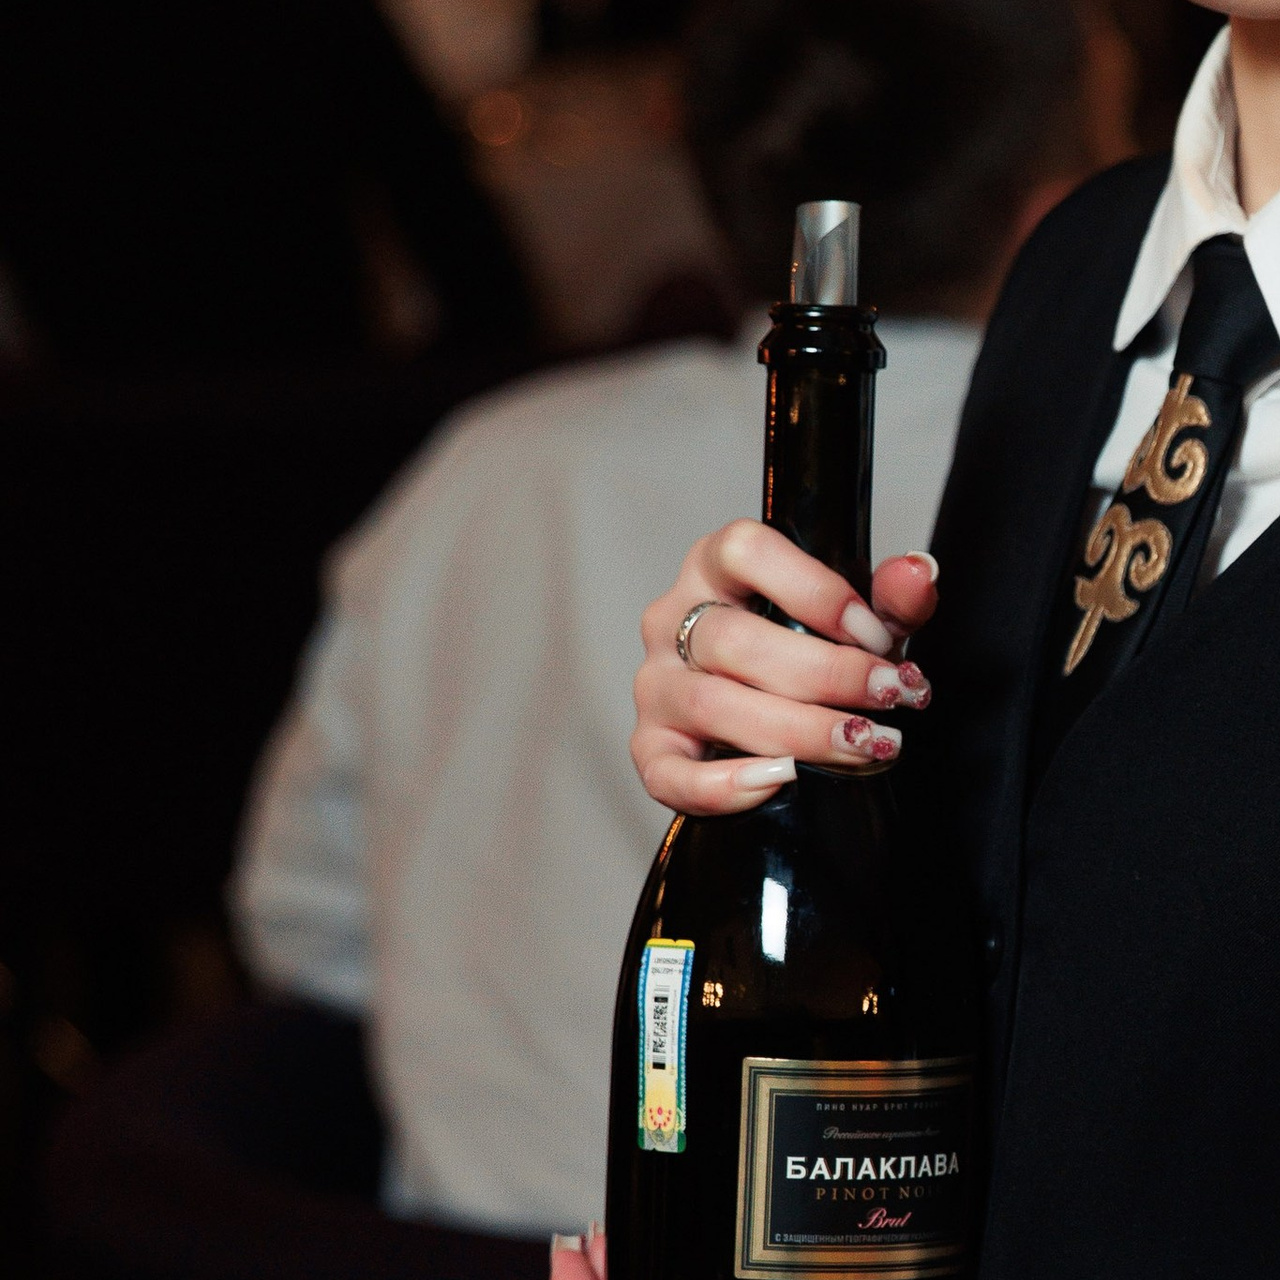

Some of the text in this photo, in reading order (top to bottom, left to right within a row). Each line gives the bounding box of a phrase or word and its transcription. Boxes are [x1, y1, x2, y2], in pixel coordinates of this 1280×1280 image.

[816, 1103, 846, 1112] ПИНО
[852, 1102, 879, 1112] НУАР
[786, 1152, 960, 1181] БАЛАКЛАВА
[816, 1187, 891, 1201] PINOT
[857, 1206, 913, 1229] Brut
